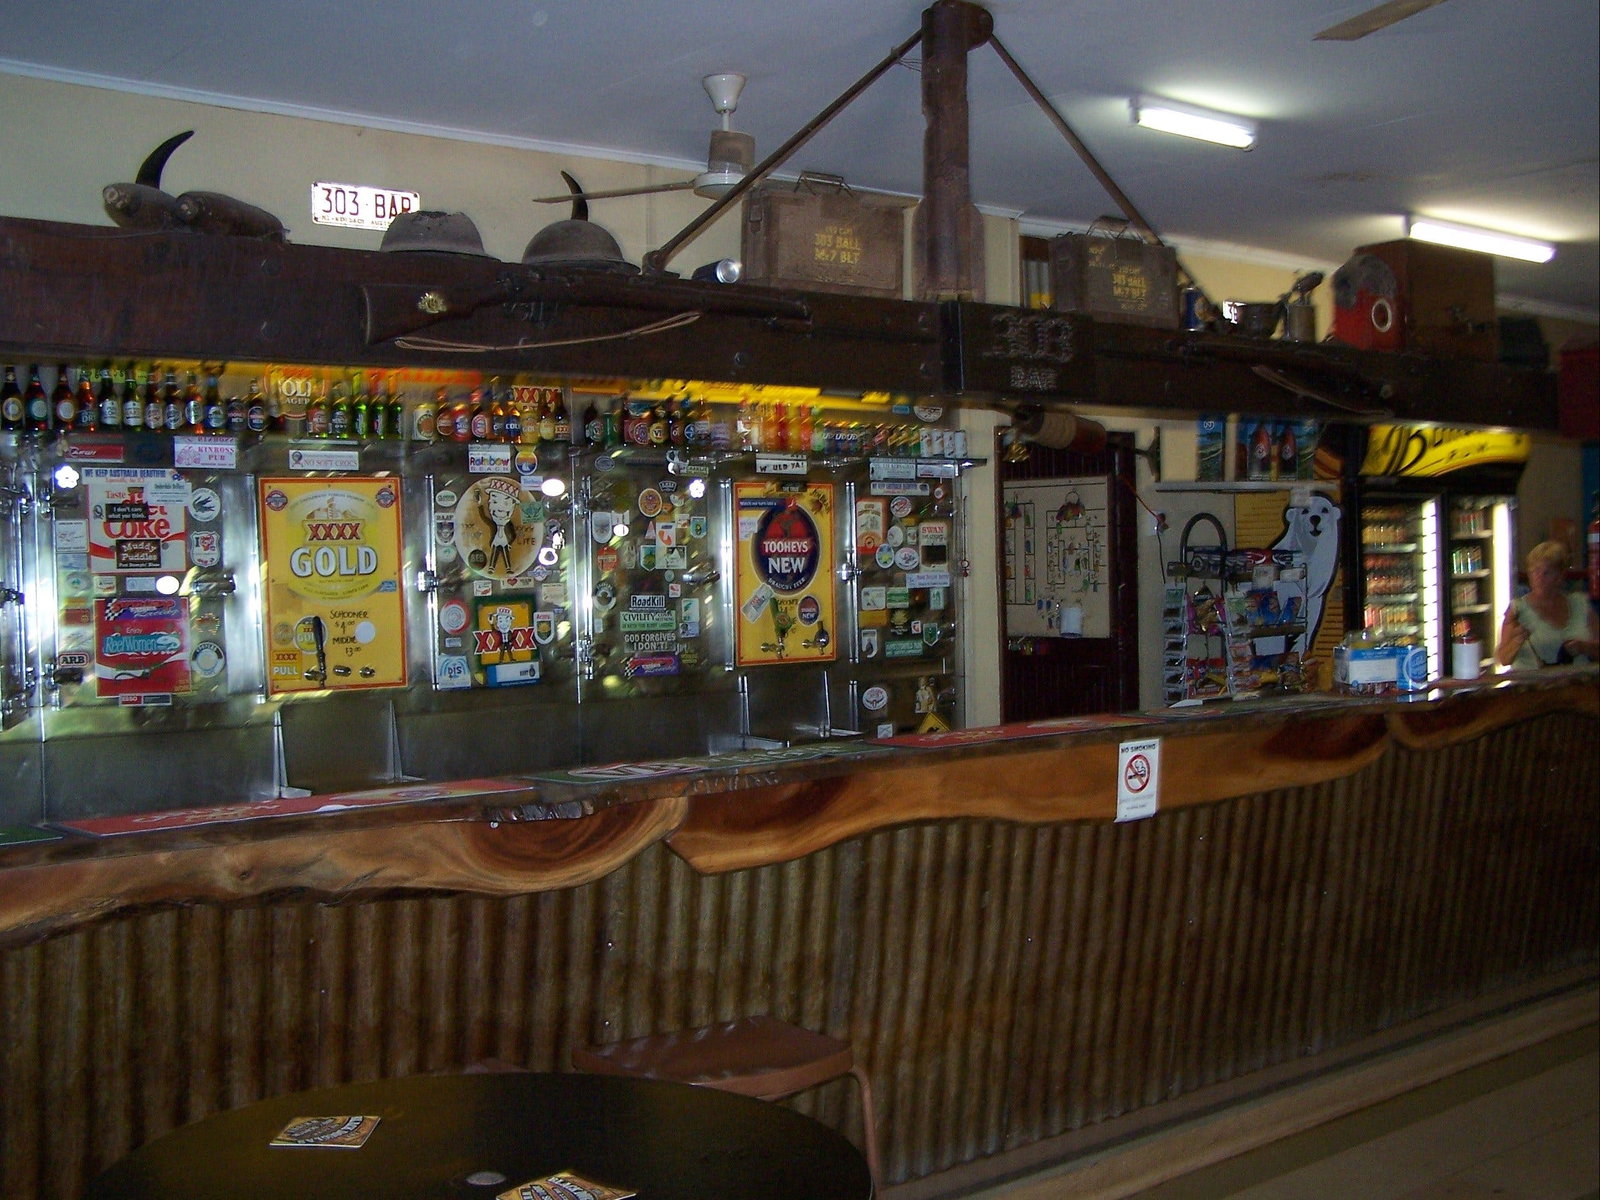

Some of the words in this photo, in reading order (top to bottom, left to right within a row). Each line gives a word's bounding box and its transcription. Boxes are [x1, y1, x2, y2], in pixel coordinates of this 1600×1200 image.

[321, 187, 359, 216] 303
[198, 446, 235, 455] KINROSS
[470, 455, 510, 467] Rainbow
[85, 469, 93, 478] WE
[95, 469, 108, 478] KEEP
[110, 469, 138, 478] AUSTRALIA
[105, 490, 126, 499] Taste
[308, 522, 361, 541] XXXX
[763, 541, 809, 553] TOOHEYS
[290, 545, 378, 577] GOLD
[768, 557, 806, 574] NEW
[624, 634, 640, 643] GOD
[641, 632, 676, 642] FORGIVES
[61, 656, 85, 665] ARB
[273, 666, 298, 675] PULL
[1120, 746, 1129, 754] NO
[1130, 743, 1157, 753] SMOKING
